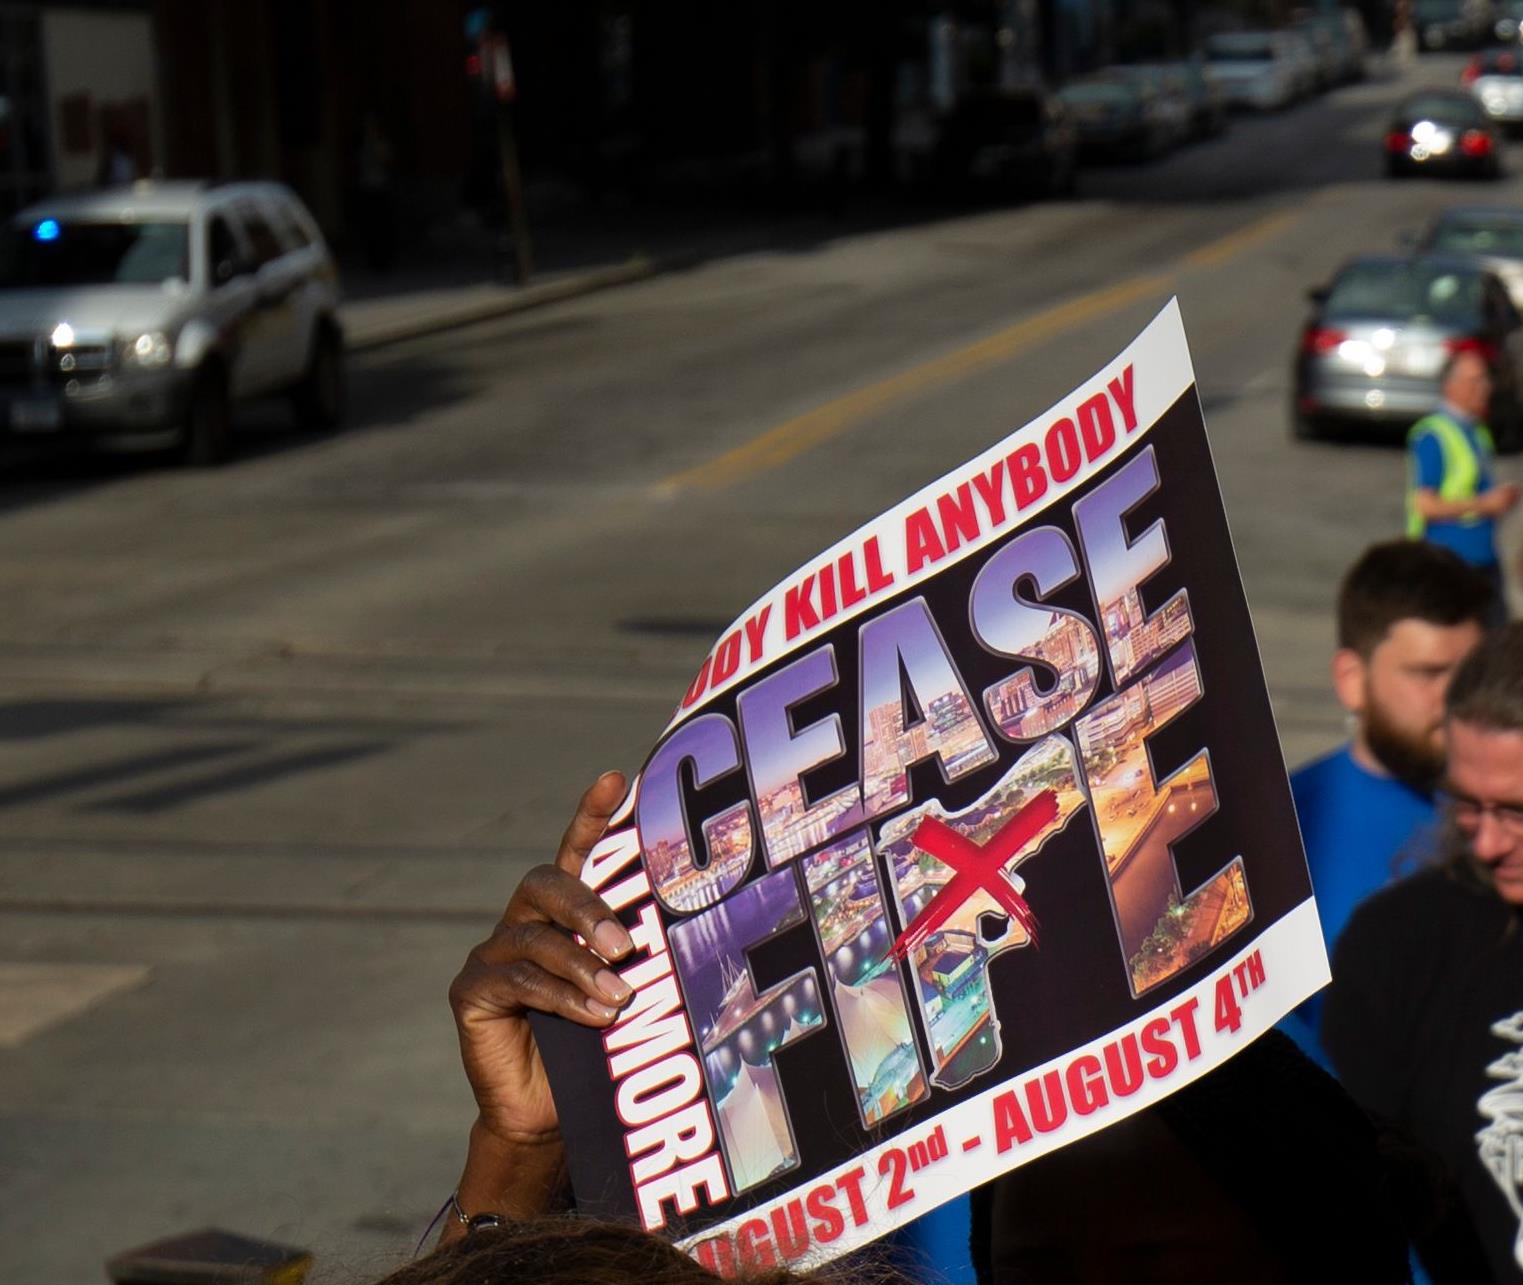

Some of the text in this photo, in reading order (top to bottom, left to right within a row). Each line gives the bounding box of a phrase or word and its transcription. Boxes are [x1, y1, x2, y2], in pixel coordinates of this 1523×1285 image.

[634, 444, 1195, 916] CEASE
[678, 363, 1142, 711] ODY KILL ANYBODY
[576, 775, 732, 1234] ALTIMORE
[694, 1166, 869, 1282] UGUST
[878, 1124, 948, 1210] 2nd
[990, 1009, 1208, 1155] AUGUST
[1211, 950, 1268, 1060] 4TH
